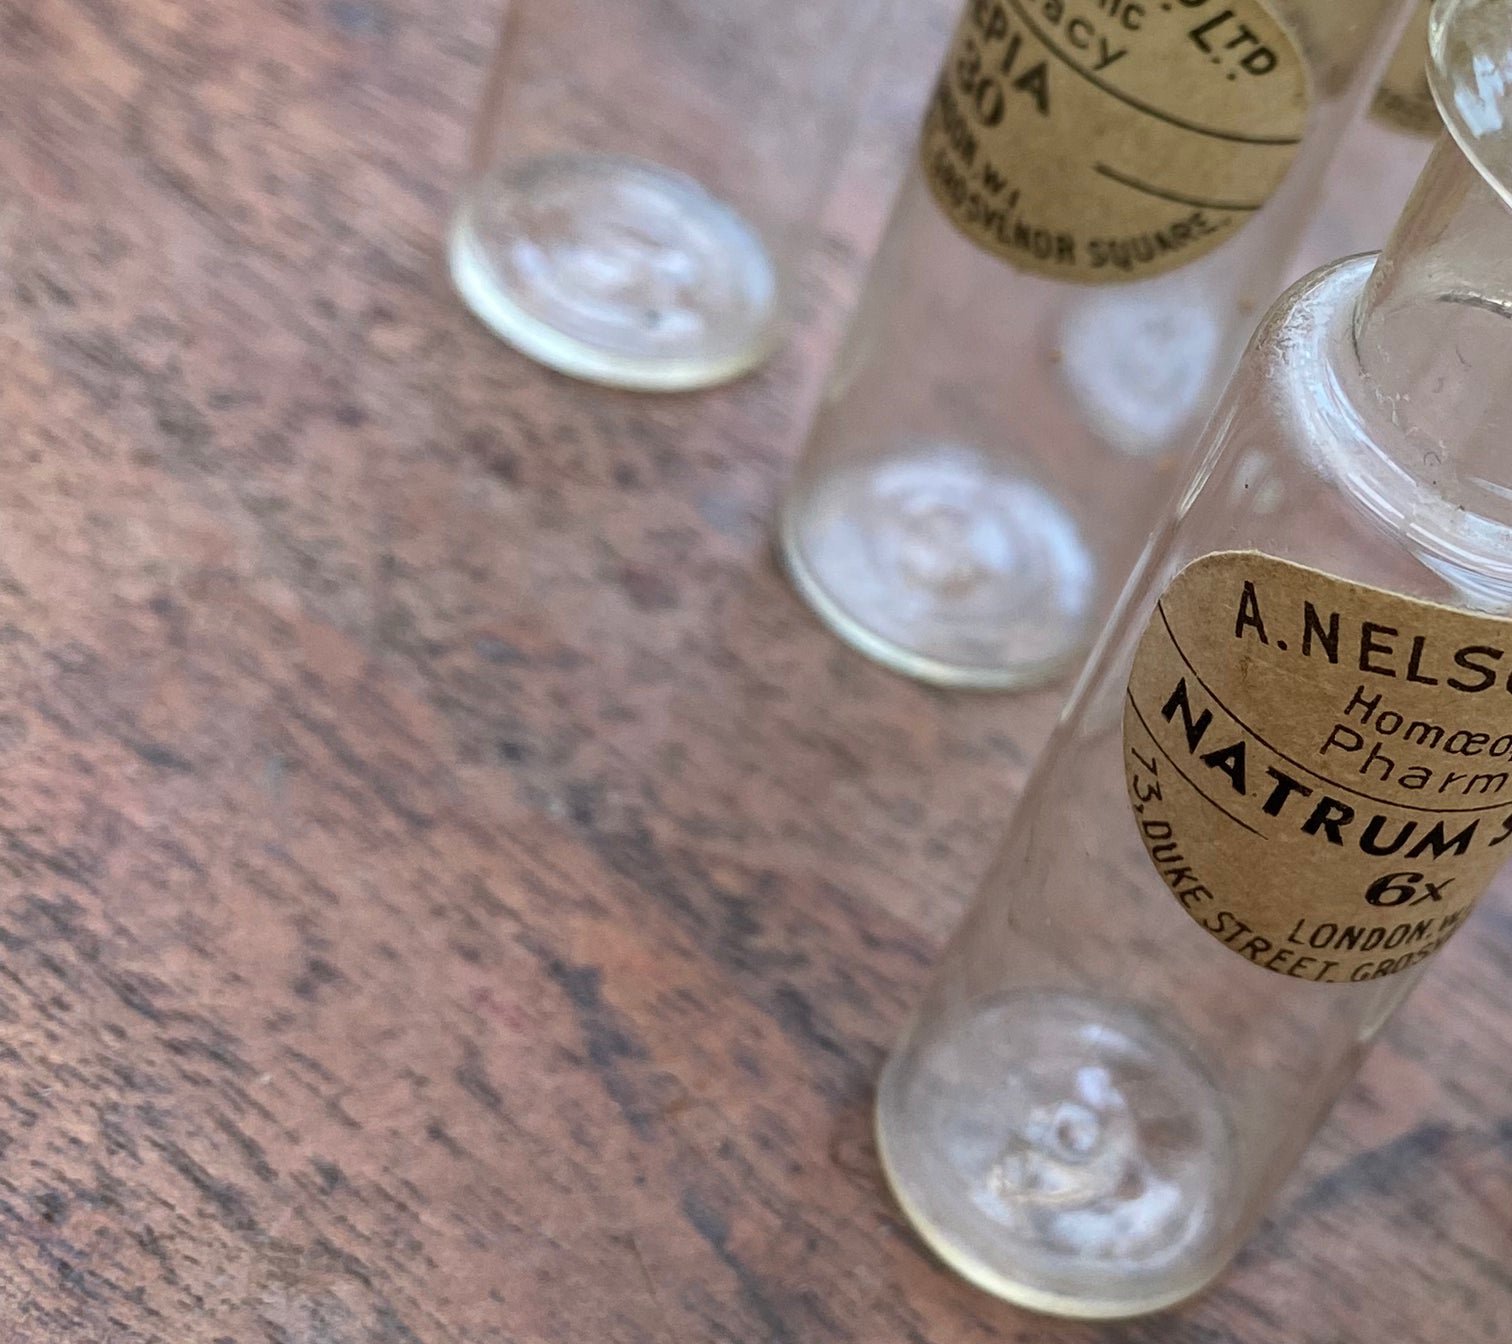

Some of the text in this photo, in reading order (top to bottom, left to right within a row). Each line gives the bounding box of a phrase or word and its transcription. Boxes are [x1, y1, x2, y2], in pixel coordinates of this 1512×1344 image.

[1160, 677, 1481, 862] NATRUM
[1141, 819, 1215, 911] DUKE
[1350, 937, 1445, 983] GROS
